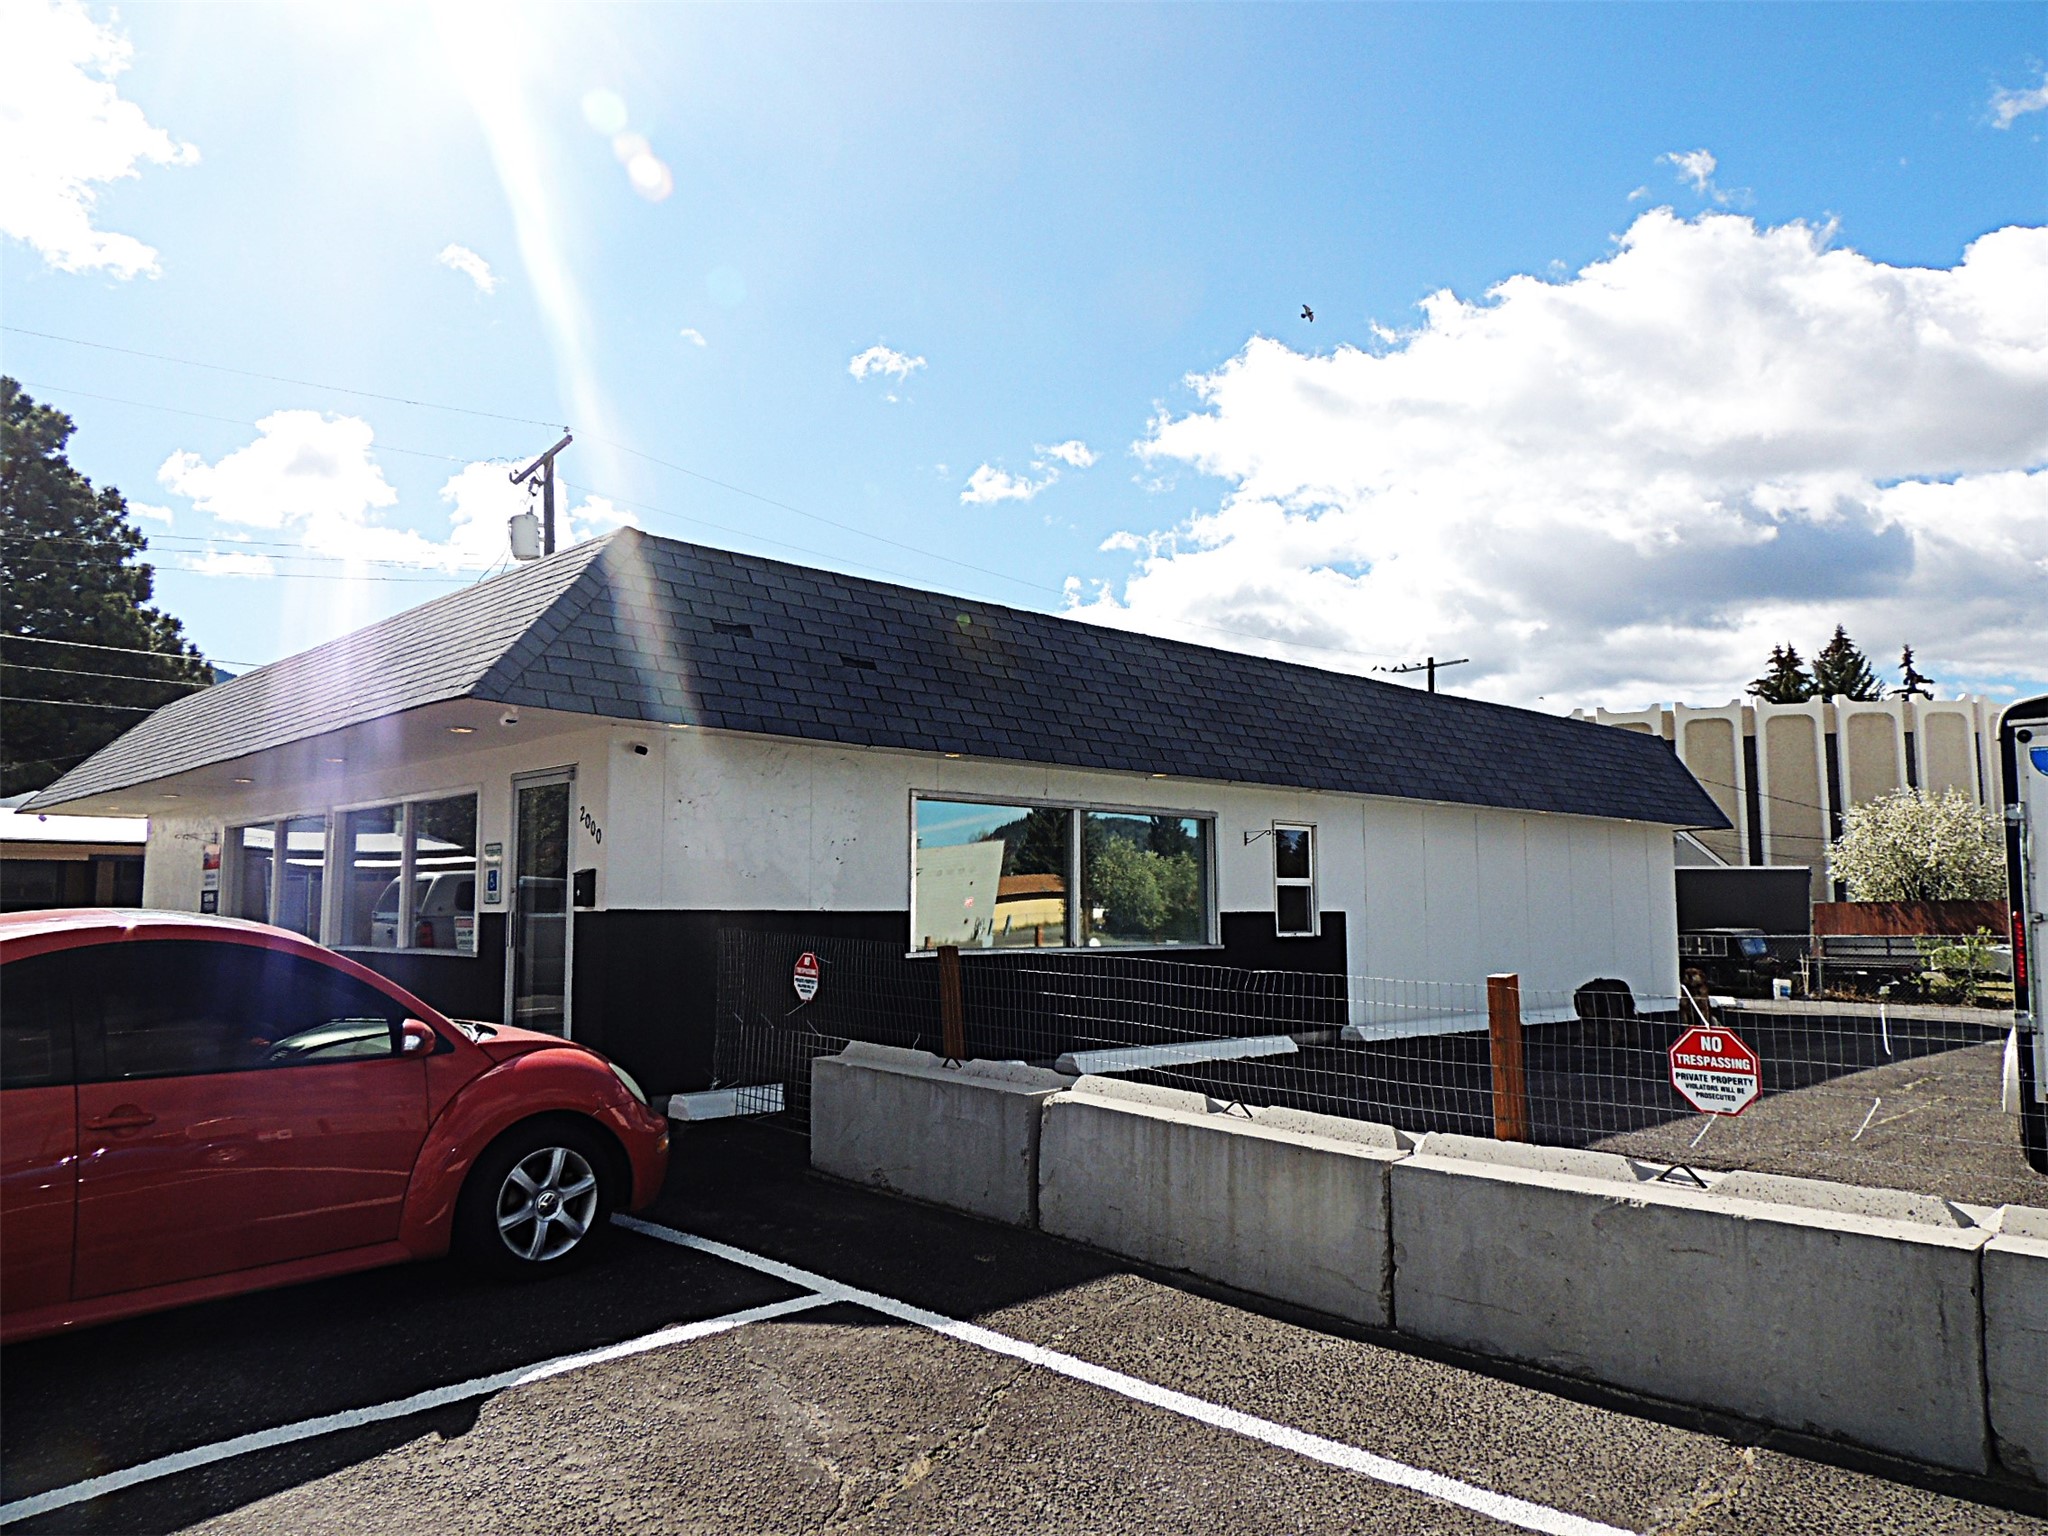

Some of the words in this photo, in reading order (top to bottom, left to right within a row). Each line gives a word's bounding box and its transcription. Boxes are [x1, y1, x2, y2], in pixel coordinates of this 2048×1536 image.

[579, 805, 602, 845] 2000
[1700, 1035, 1723, 1053] NO
[1675, 1053, 1751, 1071] TRESPASSING
[1675, 1071, 1708, 1083] PRIVATE
[1710, 1074, 1754, 1086] PROPERTY
[1685, 1082, 1720, 1092] VIOLATORS
[1720, 1086, 1735, 1094] WILL
[1695, 1091, 1737, 1102] PROSECUTED
